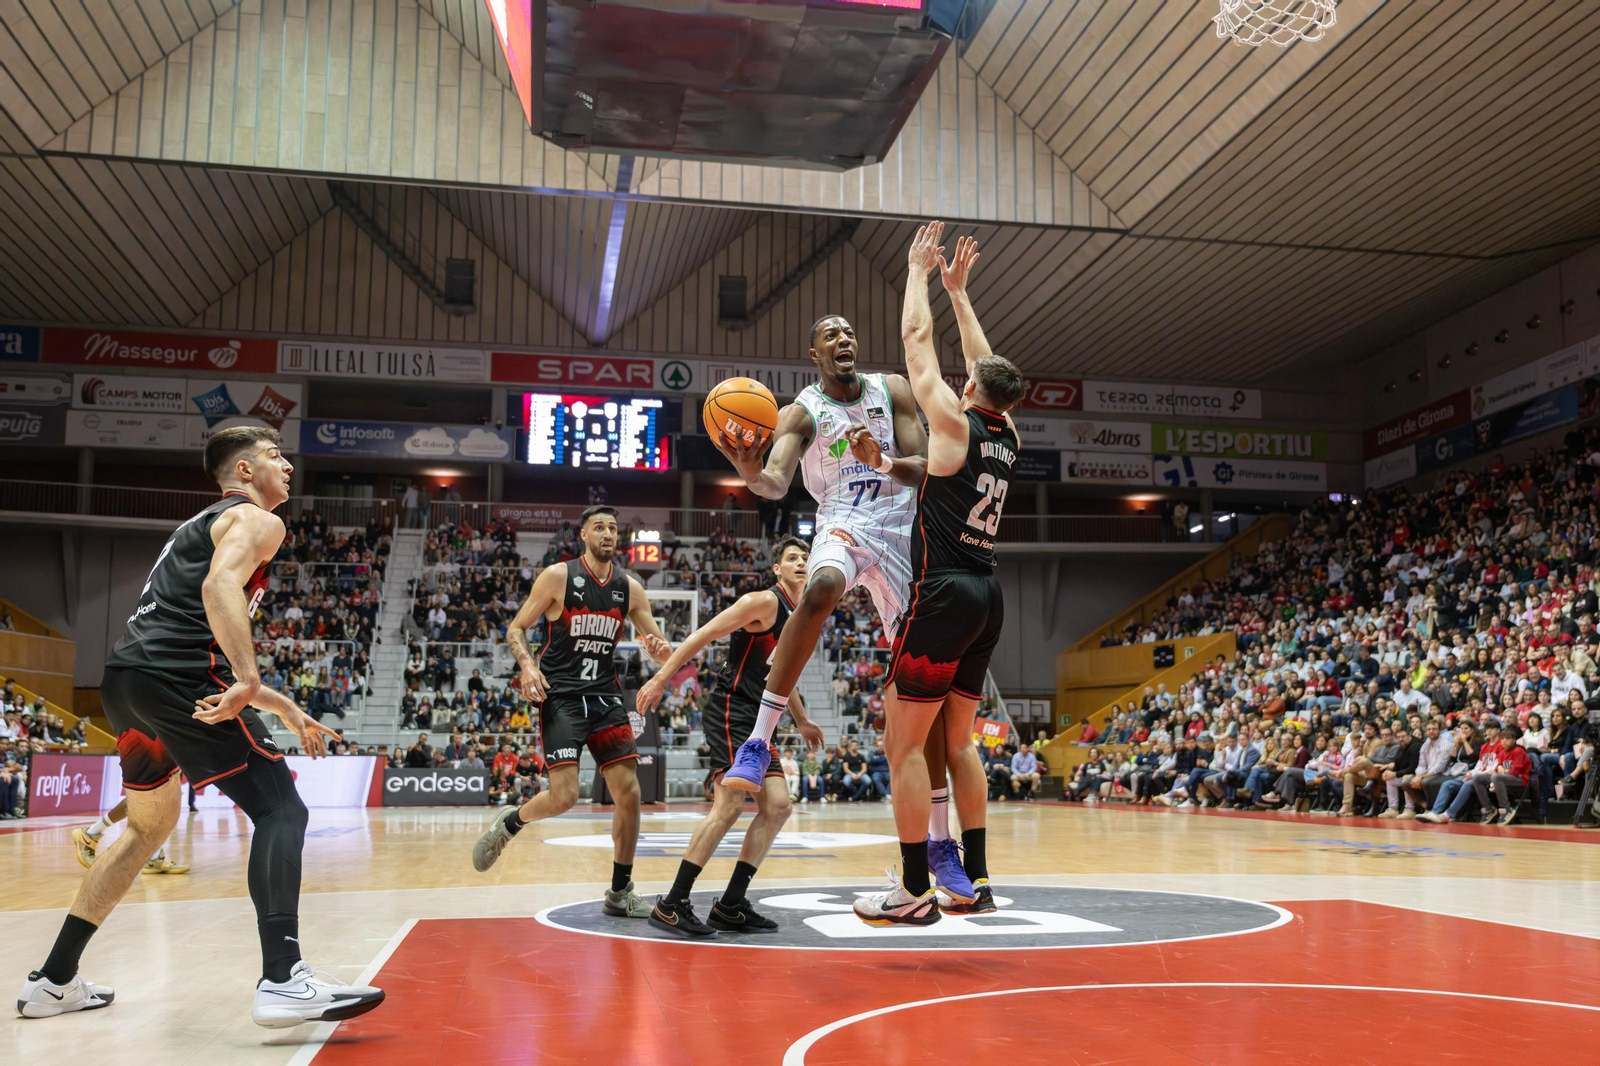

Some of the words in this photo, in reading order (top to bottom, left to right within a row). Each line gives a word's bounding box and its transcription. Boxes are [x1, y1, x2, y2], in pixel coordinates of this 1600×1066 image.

[84, 333, 198, 364] Massegur
[314, 348, 367, 374] LLEAL
[375, 350, 436, 377] TULSÀ
[538, 360, 651, 383] SPAR
[99, 389, 138, 400] CAMPS
[142, 390, 182, 401] MOTOR
[259, 396, 285, 418] ibis
[340, 426, 395, 440] infosoft
[1377, 423, 1402, 446] Diari
[1403, 418, 1417, 435] de
[1418, 404, 1454, 429] Girona
[1092, 428, 1141, 448] Abras
[1165, 428, 1312, 457] L'ESPORTIU
[1239, 469, 1272, 480] Pirineu
[1275, 471, 1286, 480] de
[1289, 472, 1319, 481] Girona
[848, 479, 882, 507] 77
[500, 508, 532, 519] girona
[534, 509, 549, 518] ets
[551, 510, 562, 518] tu
[966, 472, 1009, 537] 23
[960, 532, 980, 546] Kave
[636, 544, 659, 563] 12
[573, 639, 613, 655] FIATC
[581, 658, 599, 681] 21
[982, 722, 1001, 737] FEM
[36, 763, 71, 808] renfe
[387, 771, 485, 793] endesa
